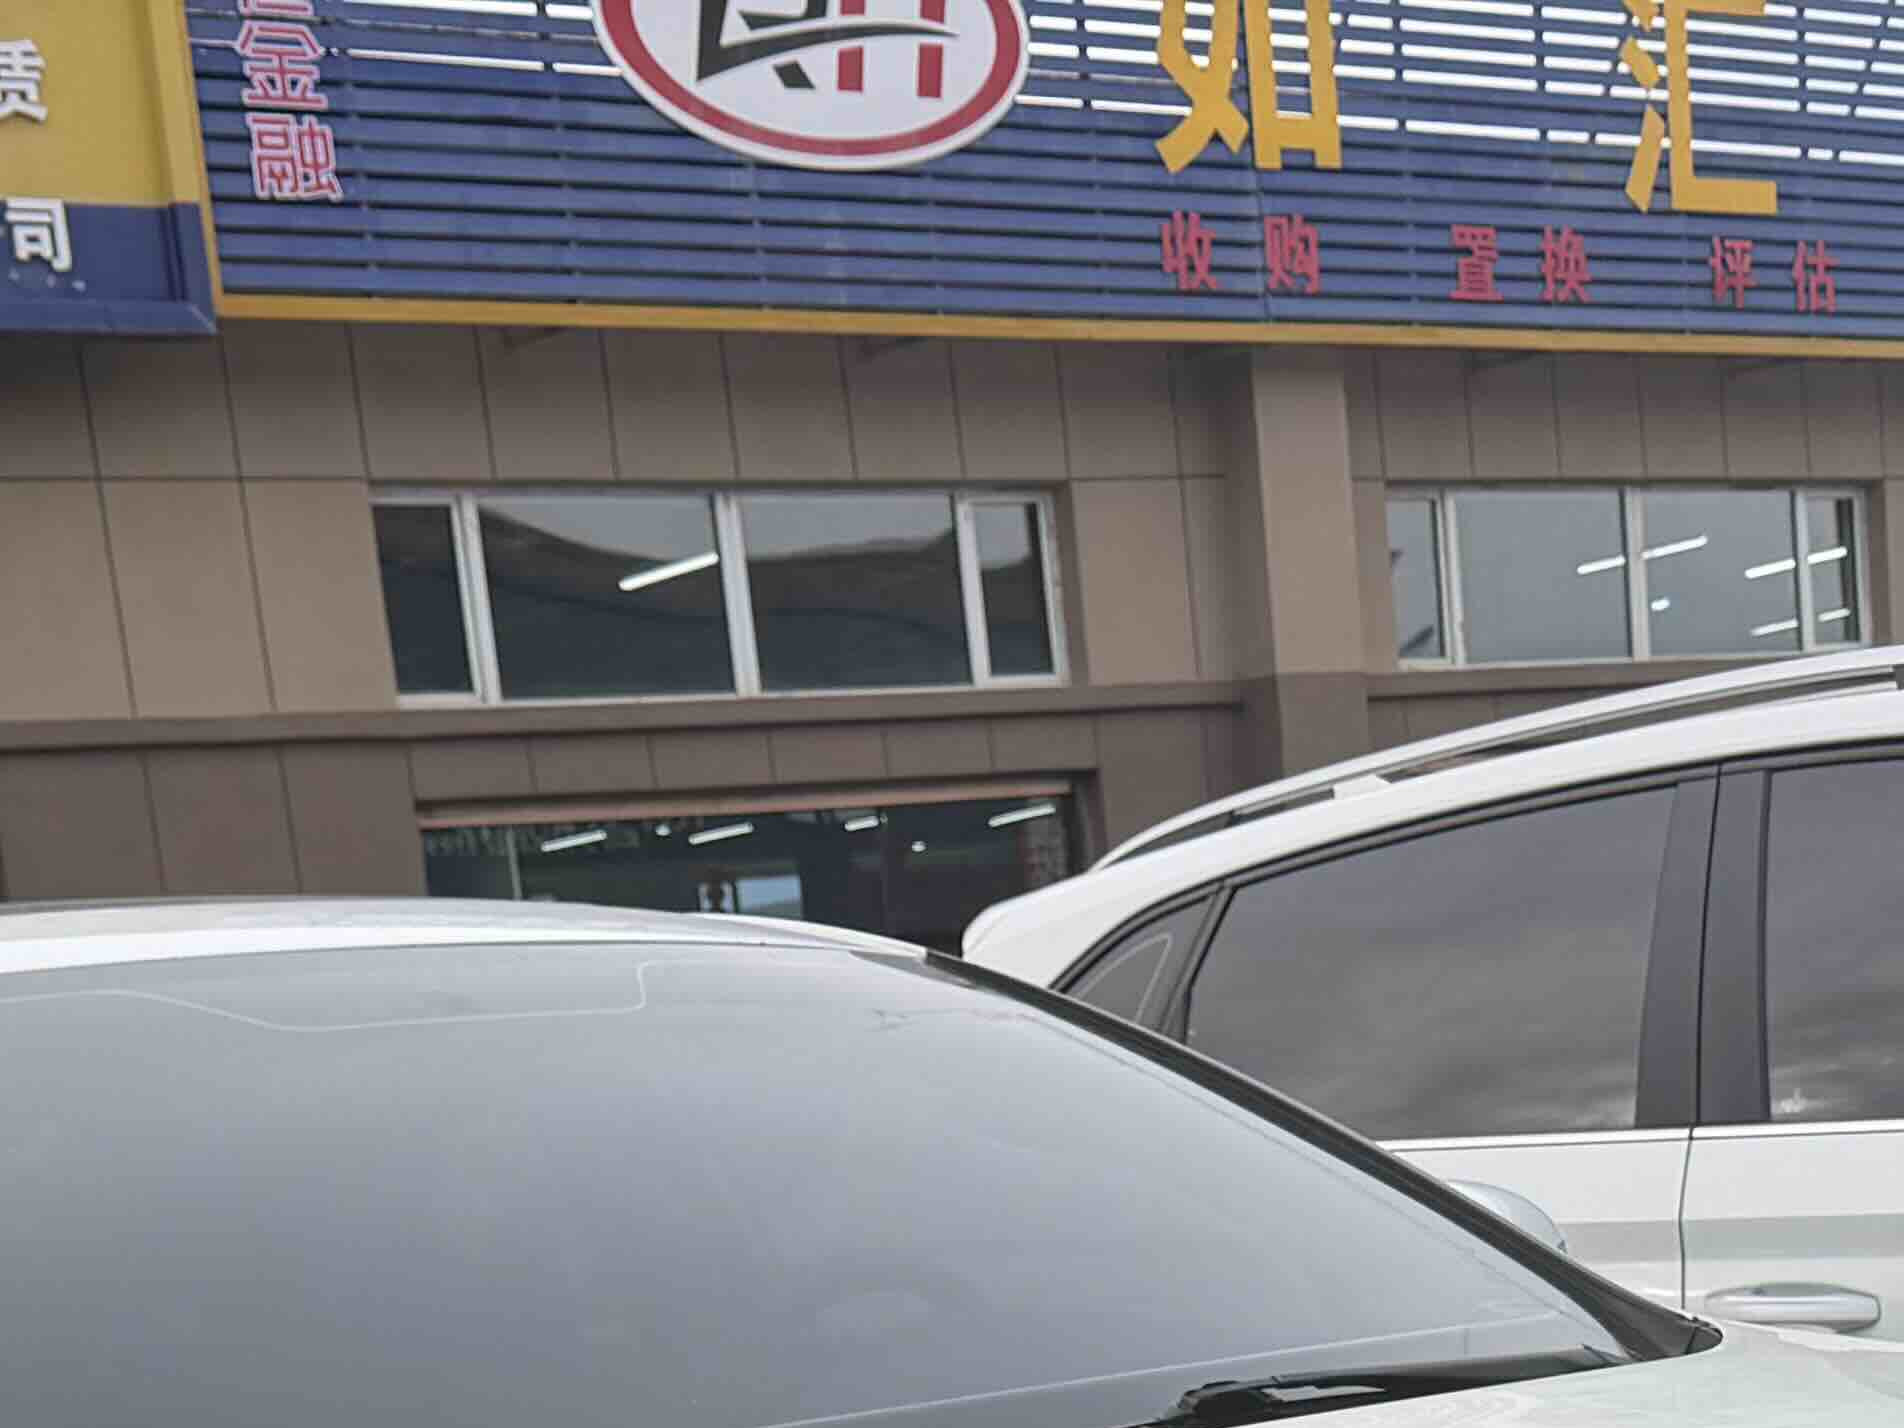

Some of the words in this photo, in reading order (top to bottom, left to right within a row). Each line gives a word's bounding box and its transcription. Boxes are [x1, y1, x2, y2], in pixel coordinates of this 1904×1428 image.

[237, 0, 344, 203] 金融
[1160, 210, 1321, 295] 收购
[1450, 224, 1593, 303] 置换
[1708, 236, 1839, 314] 评估
